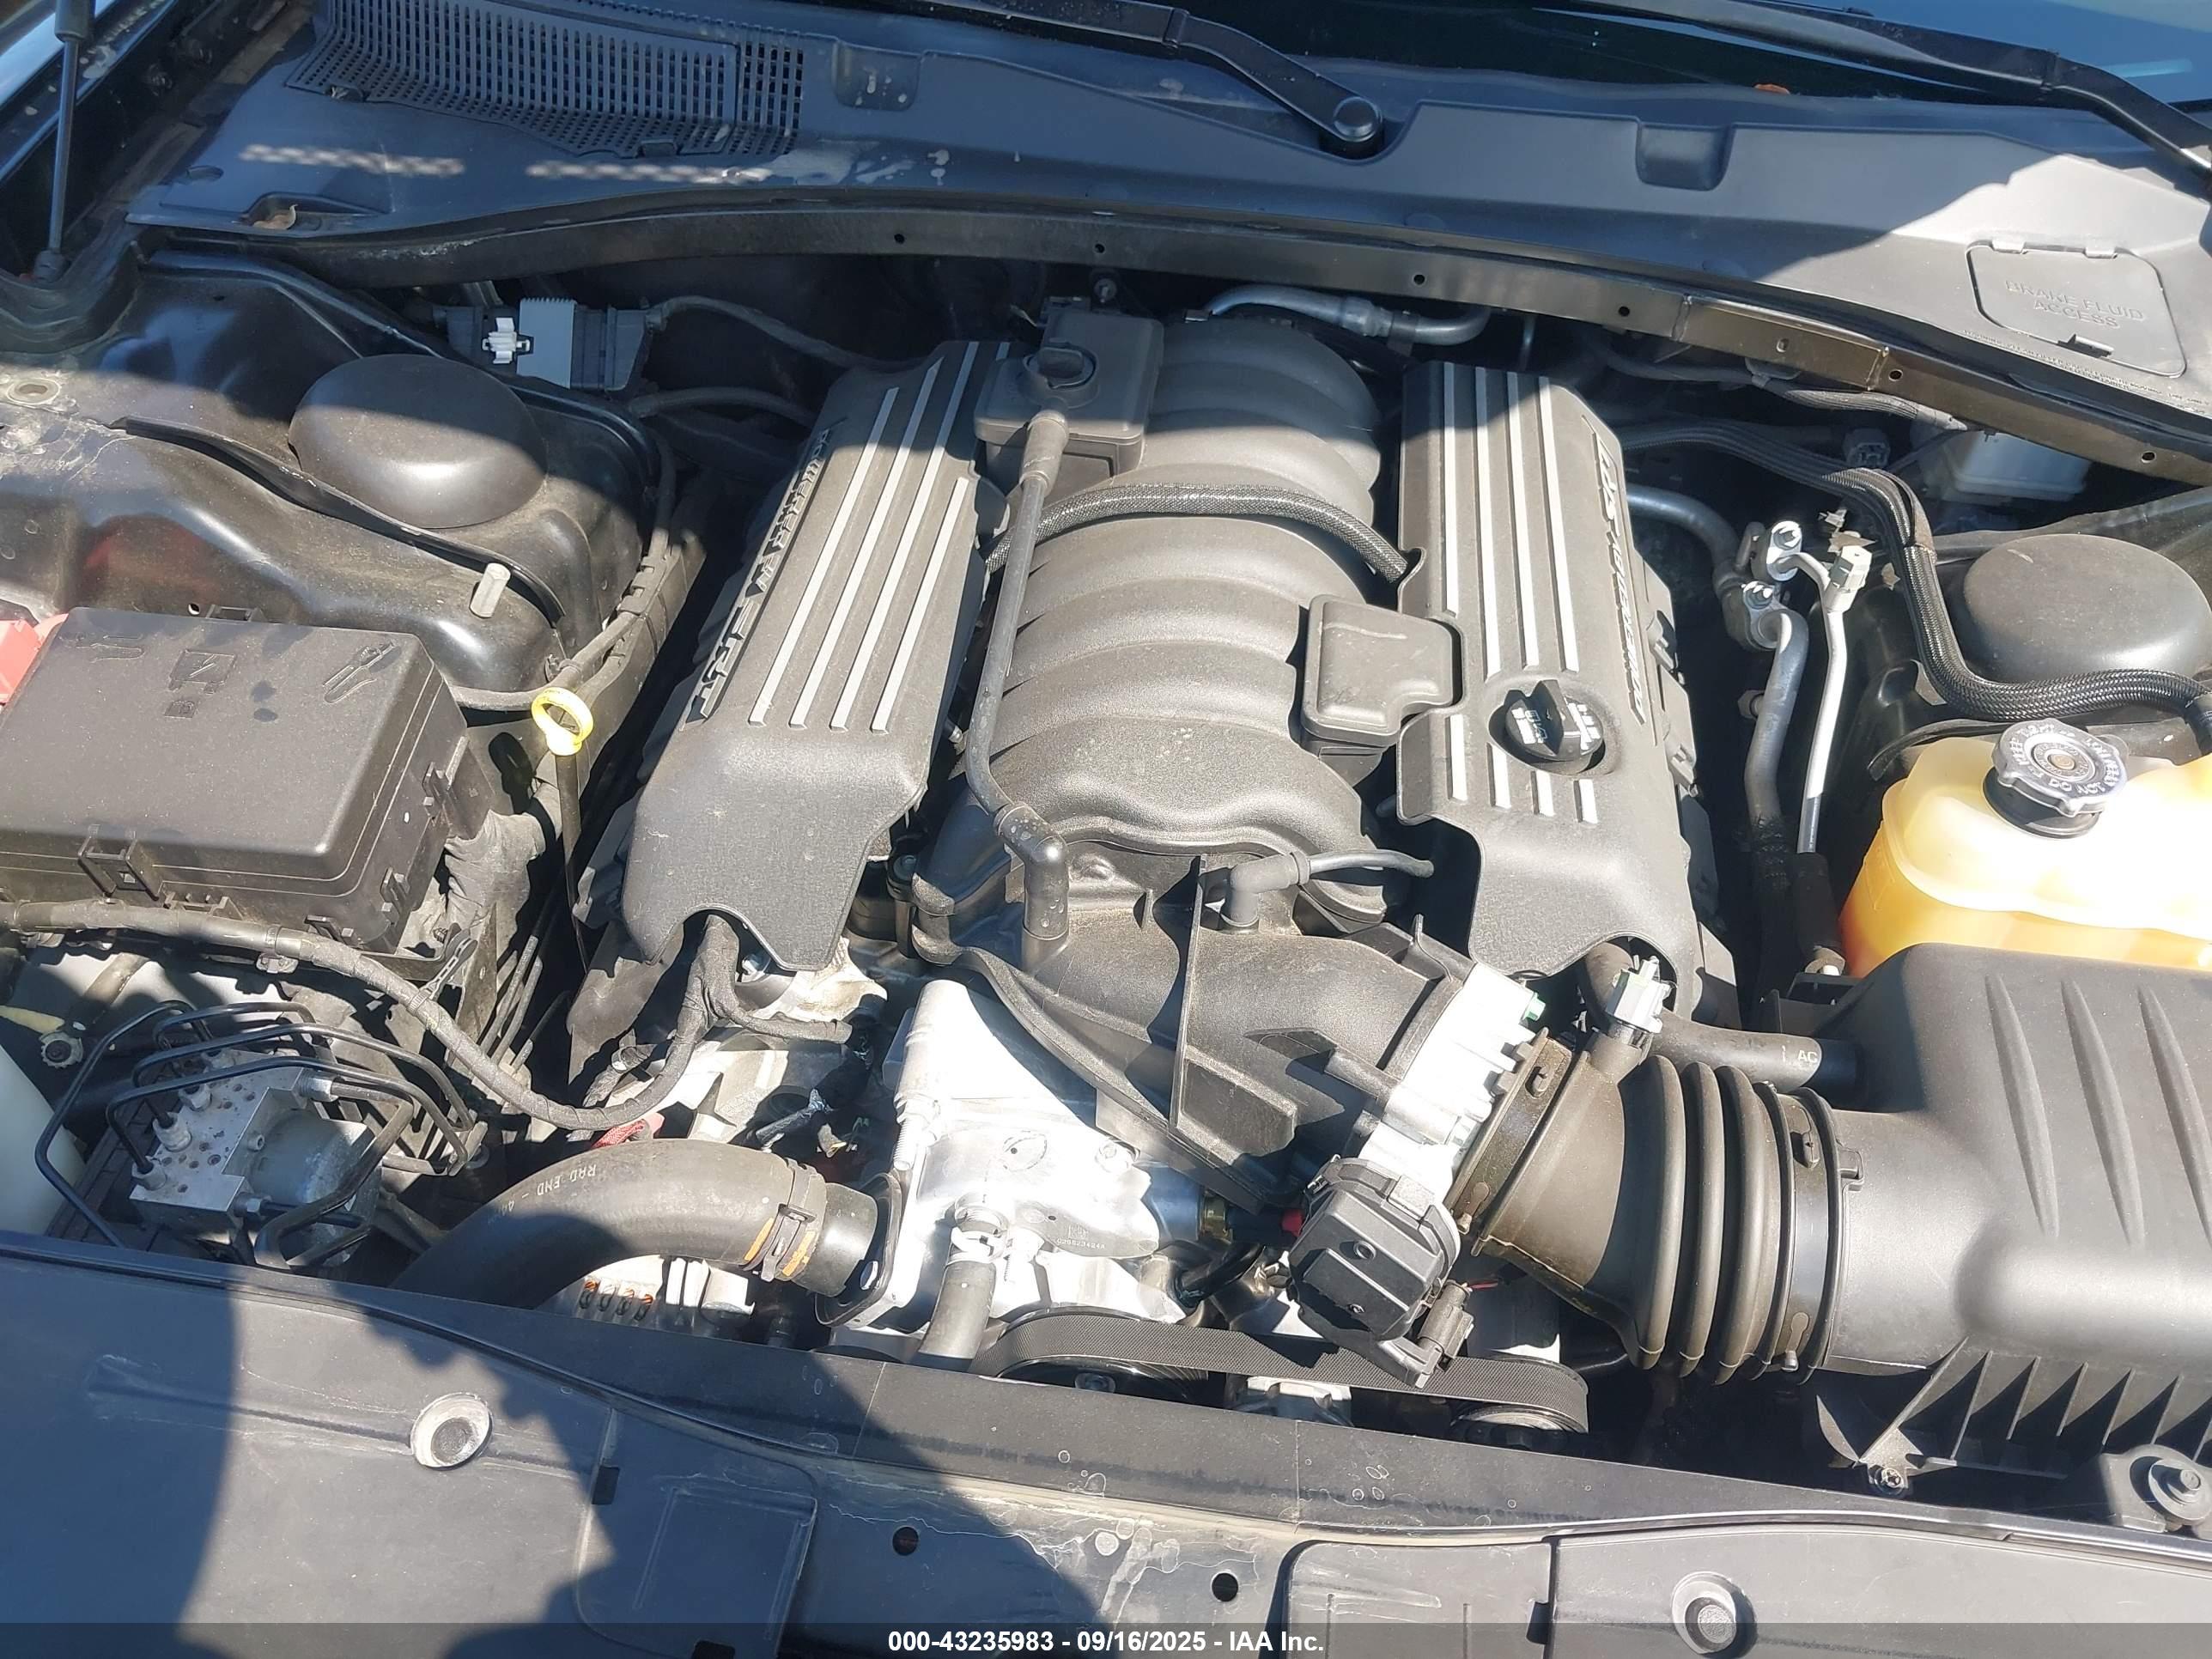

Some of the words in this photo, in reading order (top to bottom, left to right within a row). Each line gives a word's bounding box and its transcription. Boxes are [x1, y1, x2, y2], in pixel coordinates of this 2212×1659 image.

[2005, 280, 2079, 308] BRAKE
[2083, 299, 2146, 322] FLUID
[2033, 300, 2120, 329] ACCESS
[1595, 434, 1620, 536] SRT
[700, 599, 761, 719] SRT
[1615, 574, 1646, 722] POWERED
[2048, 778, 2072, 792] DO
[1797, 1049, 1818, 1063] AC
[537, 1174, 563, 1196] END
[569, 1164, 597, 1182] RAD
